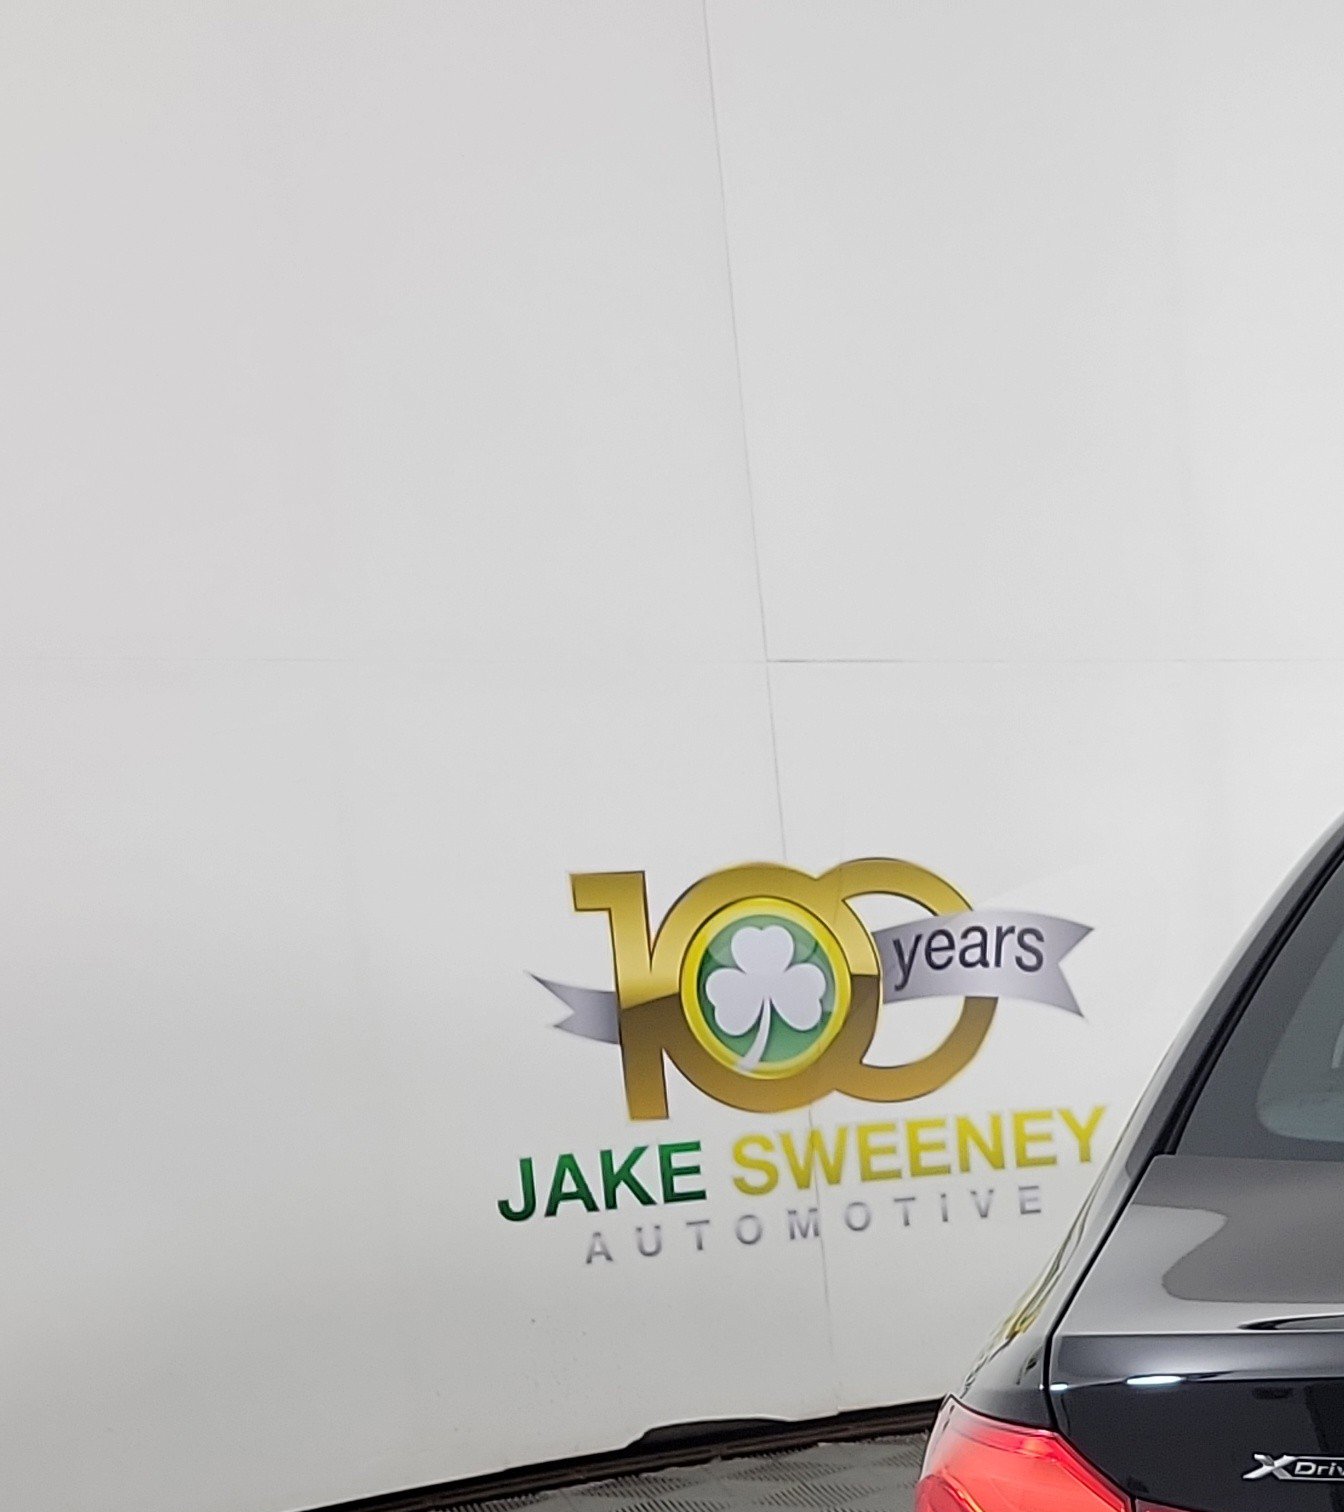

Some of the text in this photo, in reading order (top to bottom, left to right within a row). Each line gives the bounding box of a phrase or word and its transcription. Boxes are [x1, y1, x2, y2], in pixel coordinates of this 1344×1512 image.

[570, 857, 999, 1122] 100
[892, 921, 1045, 990] years
[496, 1106, 1106, 1223] JAKE SWEENEY
[585, 1185, 1043, 1266] AUTOMOTIVE
